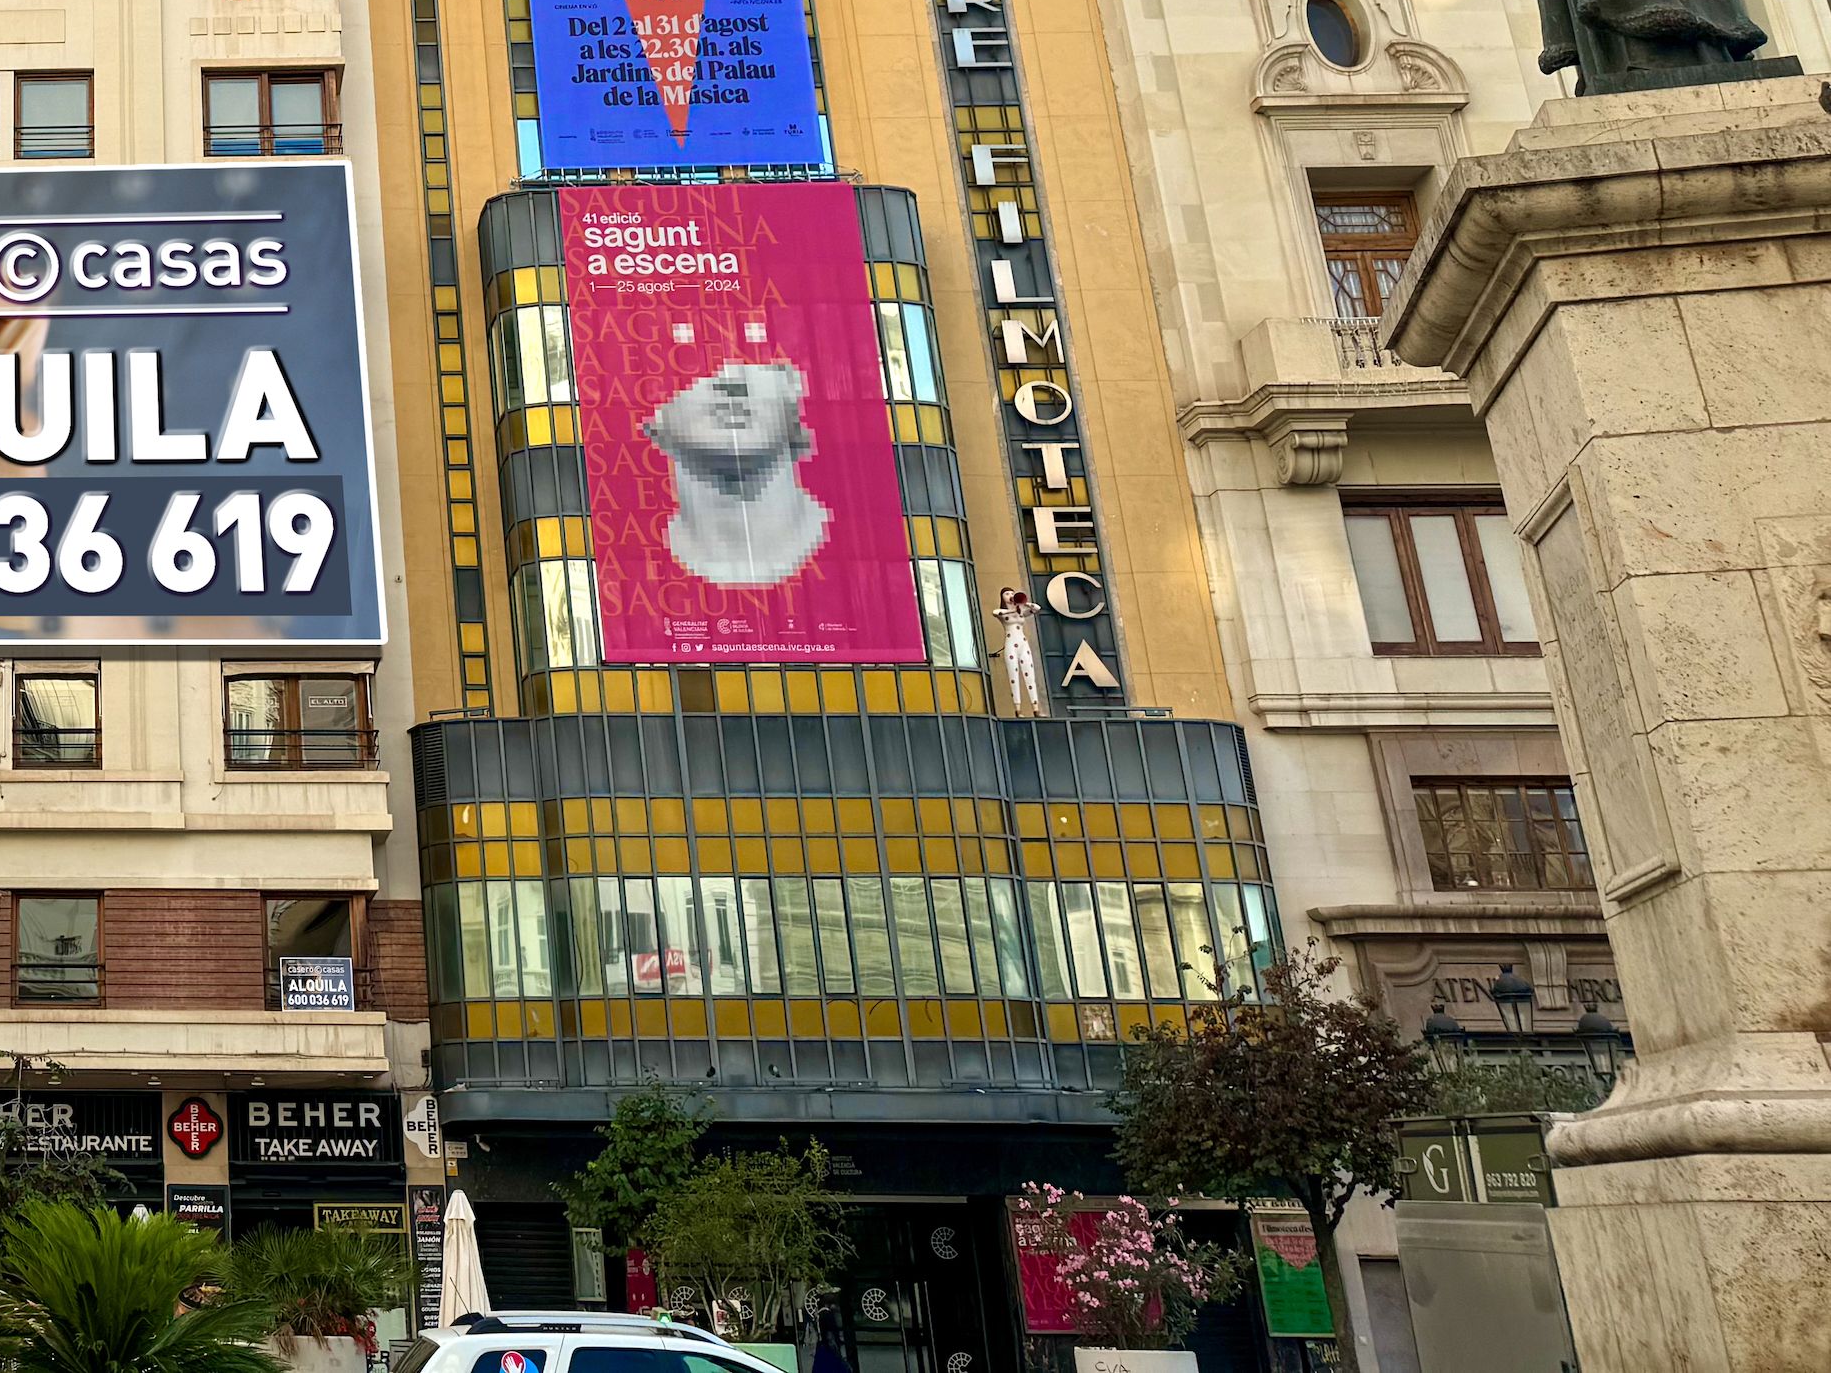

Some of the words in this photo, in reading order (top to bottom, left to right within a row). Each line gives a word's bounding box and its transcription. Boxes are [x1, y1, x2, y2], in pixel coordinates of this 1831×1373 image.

[568, 16, 609, 37] Del
[612, 16, 627, 36] 2
[631, 15, 652, 36] al
[656, 15, 680, 36] 31
[684, 13, 770, 37] d'agost
[580, 44, 594, 60] a
[598, 40, 631, 60] les
[635, 36, 725, 59] 22.30h.
[729, 36, 763, 57] als
[571, 63, 662, 84] Jardins
[666, 61, 703, 82] del
[708, 60, 776, 80] Palau
[603, 87, 633, 106] de
[637, 86, 659, 106] la
[663, 84, 750, 106] Música
[582, 213, 598, 224] 41
[600, 212, 642, 225] edició
[585, 220, 702, 253] sagunt
[72, 237, 289, 291] casas
[587, 254, 607, 275] a
[614, 251, 739, 275] escena
[705, 279, 741, 291] 2024
[971, 144, 1120, 688] FILMOTECA
[151, 490, 336, 594] 619
[711, 642, 836, 654] saguntaescena.ivc.gva.es
[289, 979, 347, 992] ALQUILA
[288, 994, 308, 1005] 600
[309, 994, 329, 1005] 036
[331, 994, 349, 1006] 619
[248, 1101, 382, 1128] BEHER
[173, 1122, 217, 1132] BEHER
[190, 1104, 200, 1151] BEHER
[426, 1099, 439, 1155] BEHER
[255, 1138, 313, 1157] TAKE
[316, 1138, 378, 1158] AWAY
[1485, 1172, 1502, 1187] 963
[1503, 1172, 1519, 1187] 792
[1520, 1172, 1536, 1187] 820
[173, 1194, 206, 1202] Descubre
[178, 1204, 224, 1214] PARRILLA
[417, 1235, 441, 1243] JAMÓN
